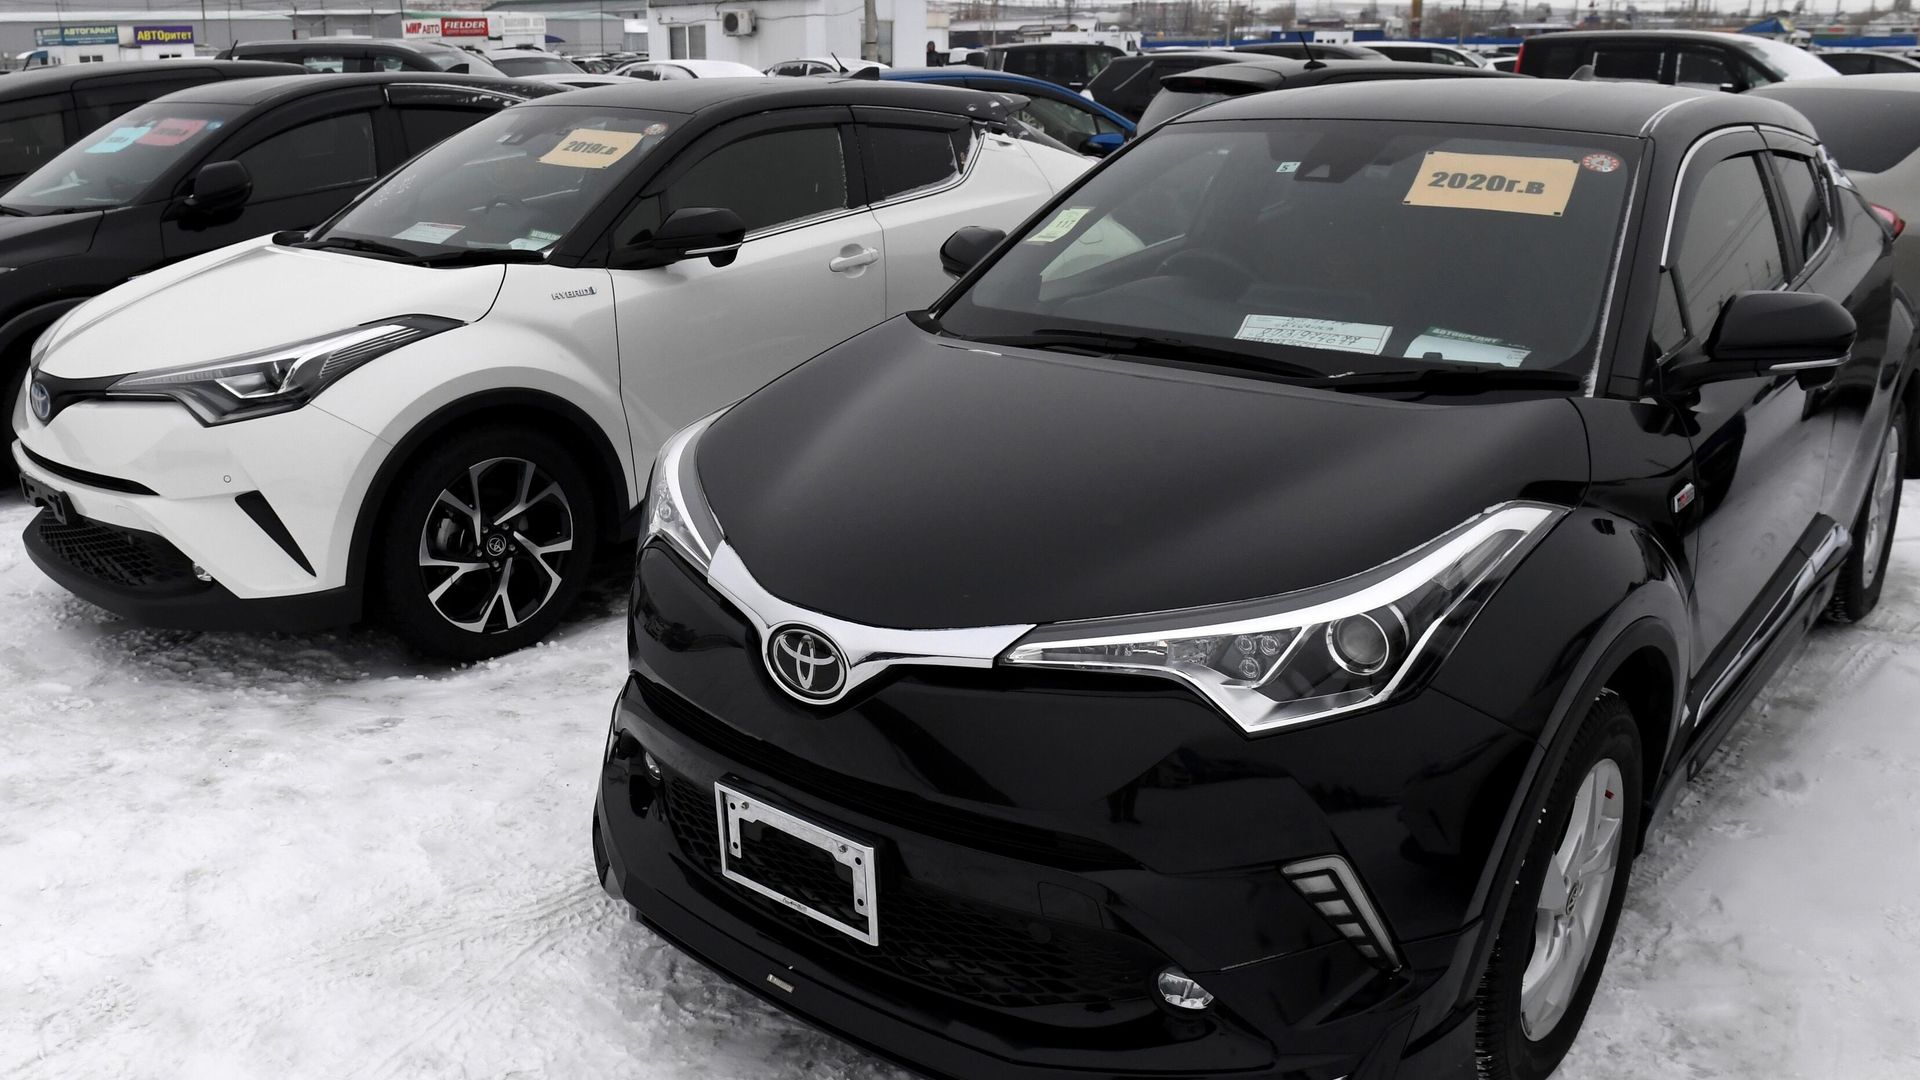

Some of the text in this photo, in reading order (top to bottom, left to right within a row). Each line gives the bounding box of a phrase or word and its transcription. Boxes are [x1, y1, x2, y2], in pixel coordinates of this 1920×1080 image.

[63, 26, 116, 36] АВТОГАРАНТ
[405, 22, 422, 34] МИР
[443, 21, 486, 30] FIELDER
[136, 30, 193, 43] АВТОритет
[1427, 171, 1546, 195] 2020г.в
[551, 287, 591, 301] HYBRID
